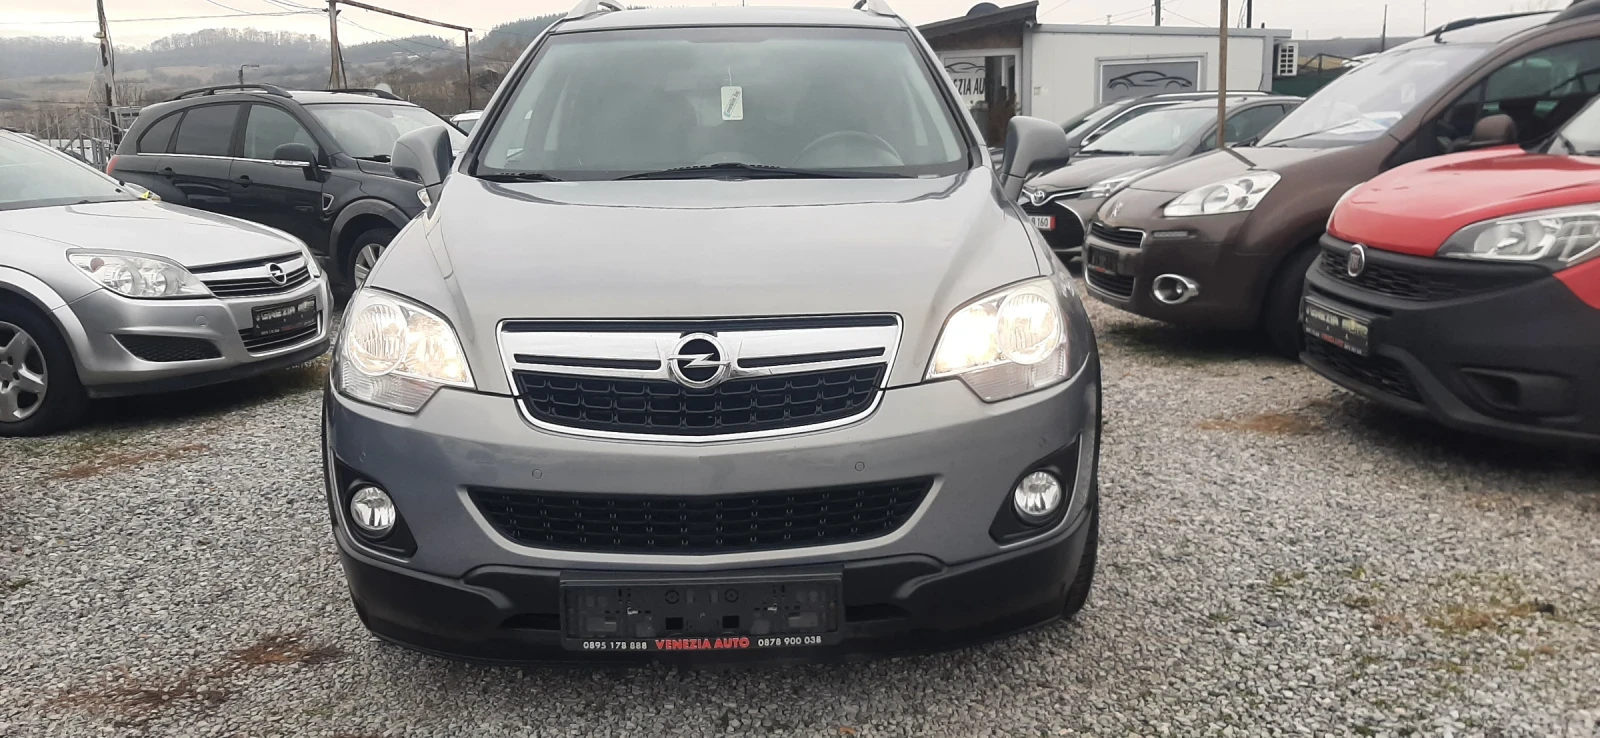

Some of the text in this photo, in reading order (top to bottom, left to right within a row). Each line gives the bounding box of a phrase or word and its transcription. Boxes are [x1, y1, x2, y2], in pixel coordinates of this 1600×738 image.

[583, 636, 822, 650] 0895 178 888 VENEZIA AUTO 0878 900 038
